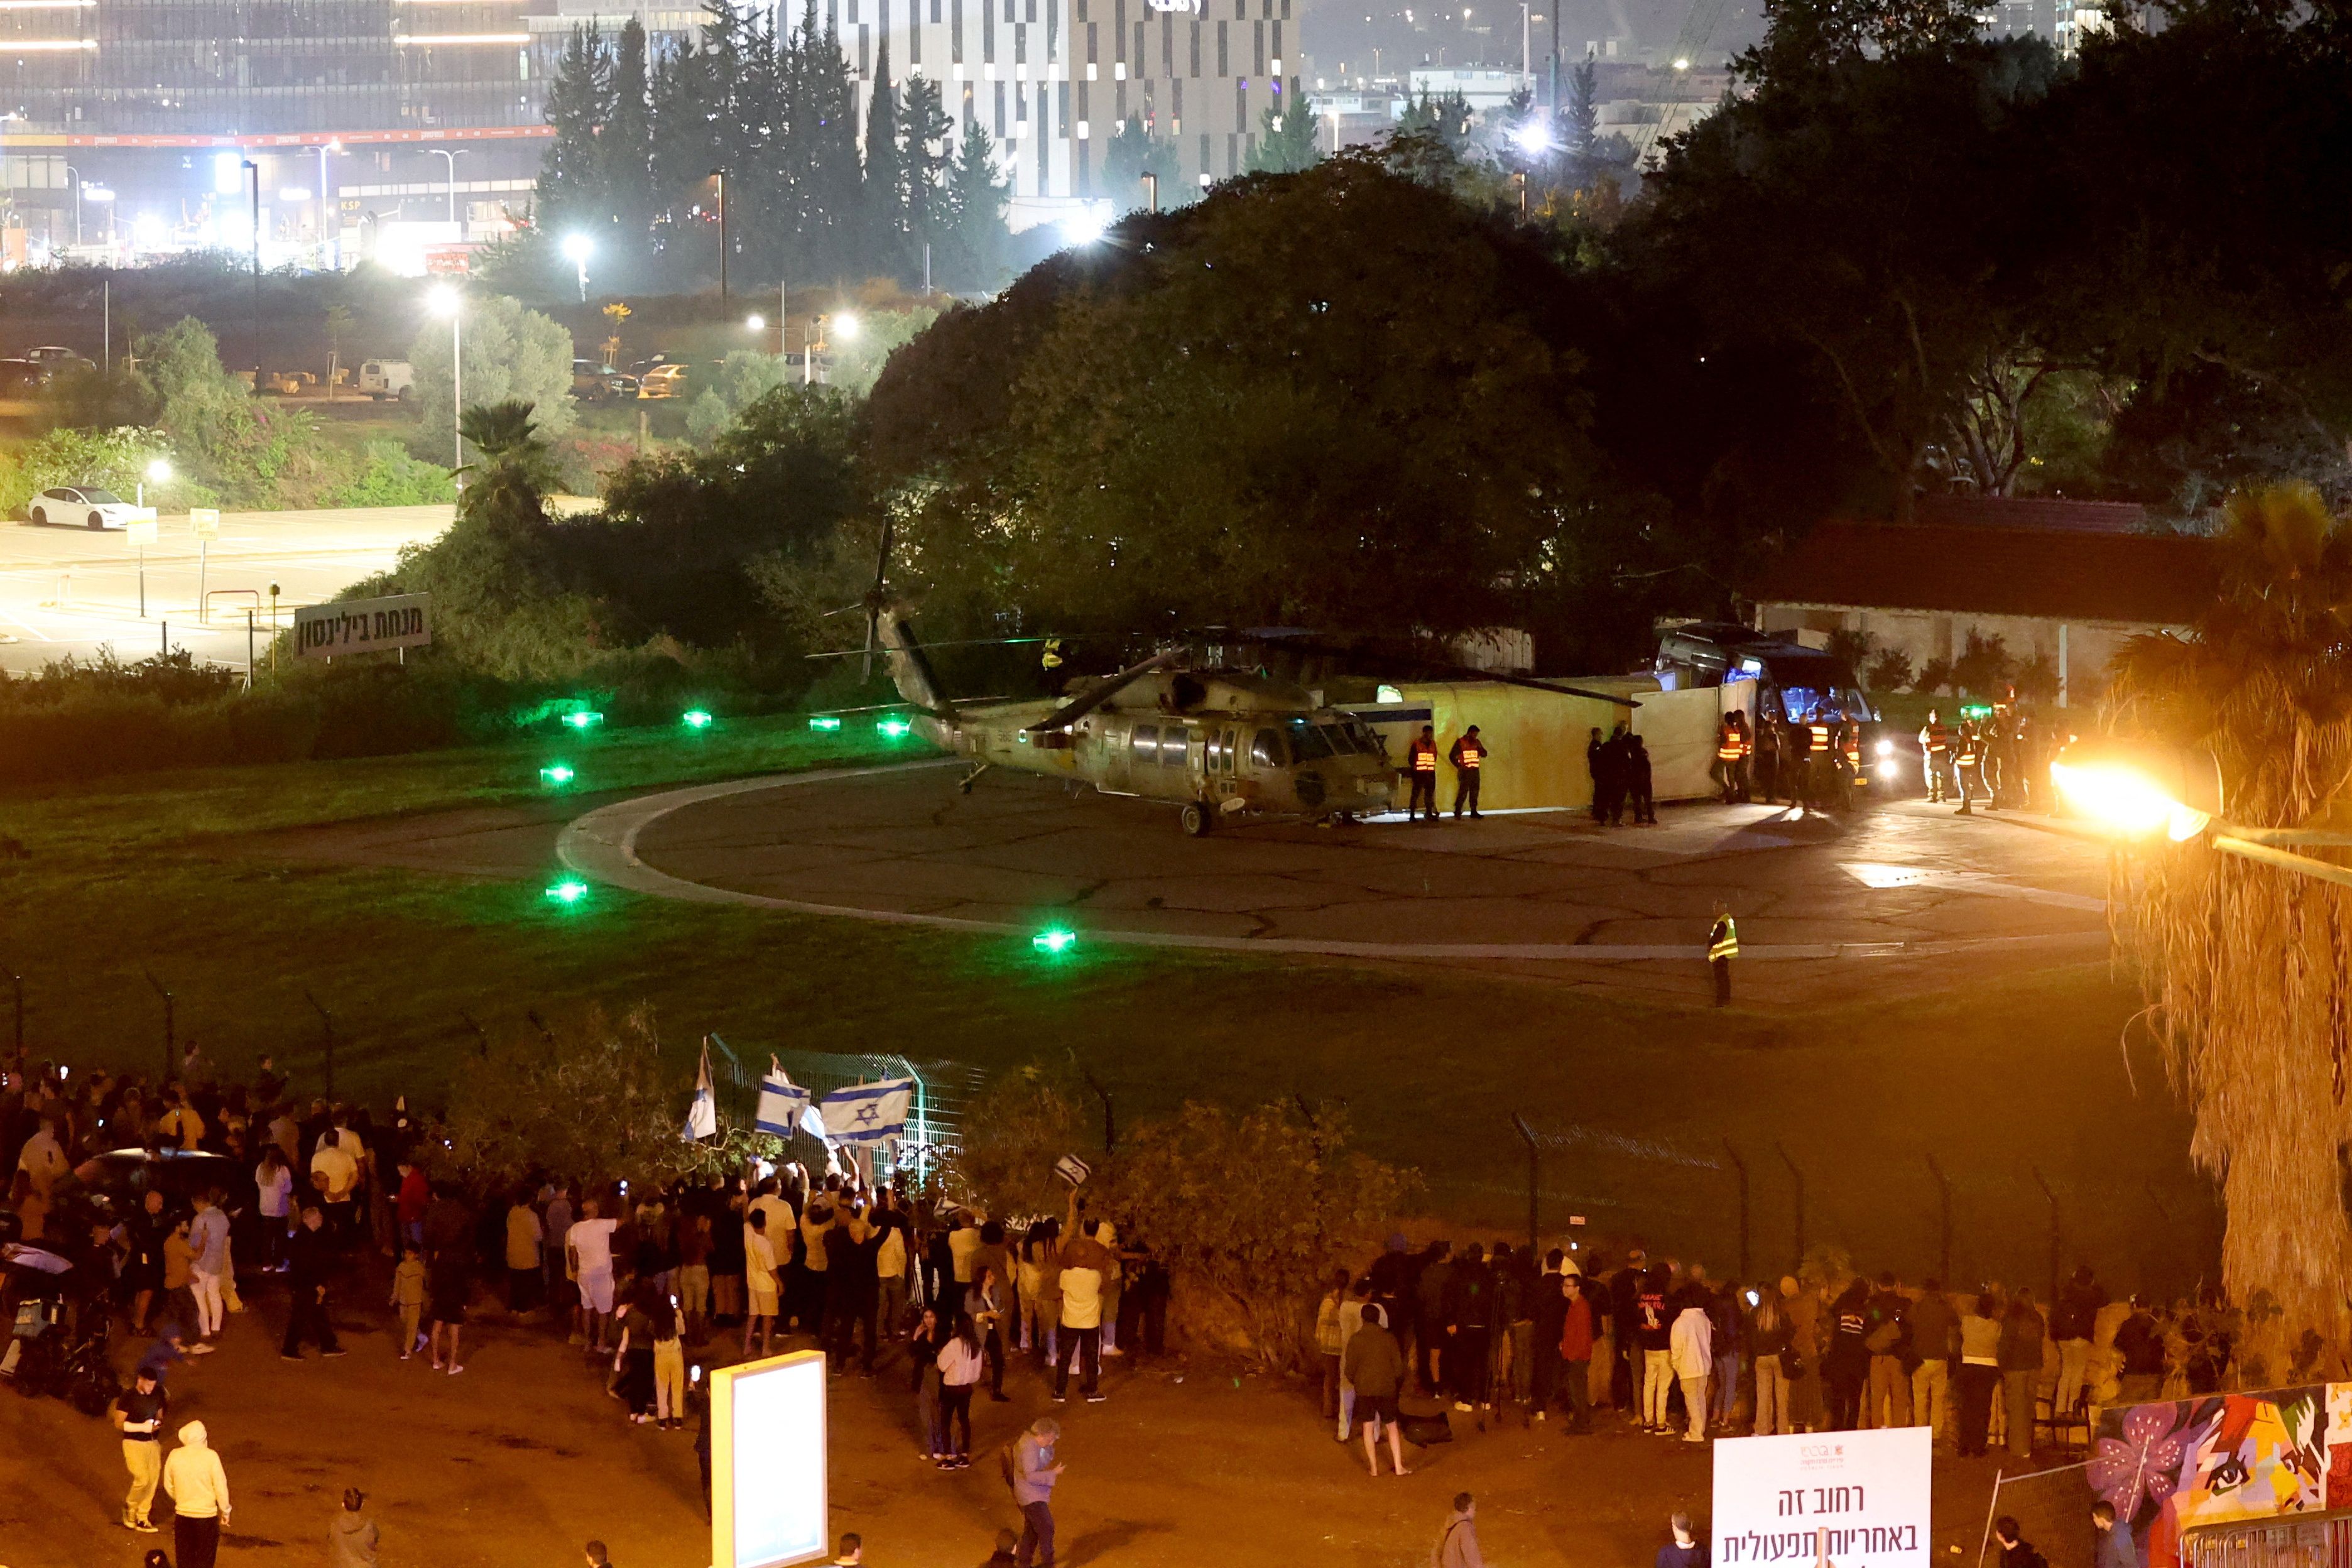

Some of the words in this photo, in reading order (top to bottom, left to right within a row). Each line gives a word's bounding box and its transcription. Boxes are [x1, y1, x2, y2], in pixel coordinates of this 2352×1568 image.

[341, 201, 361, 210] KSP
[298, 611, 370, 656] בילינסון
[374, 607, 423, 640] מנחת
[1779, 1489, 1805, 1516] זה
[1813, 1486, 1864, 1514] רחוב
[1723, 1530, 1817, 1562] תפעולית
[1827, 1525, 1918, 1555] באחריות
